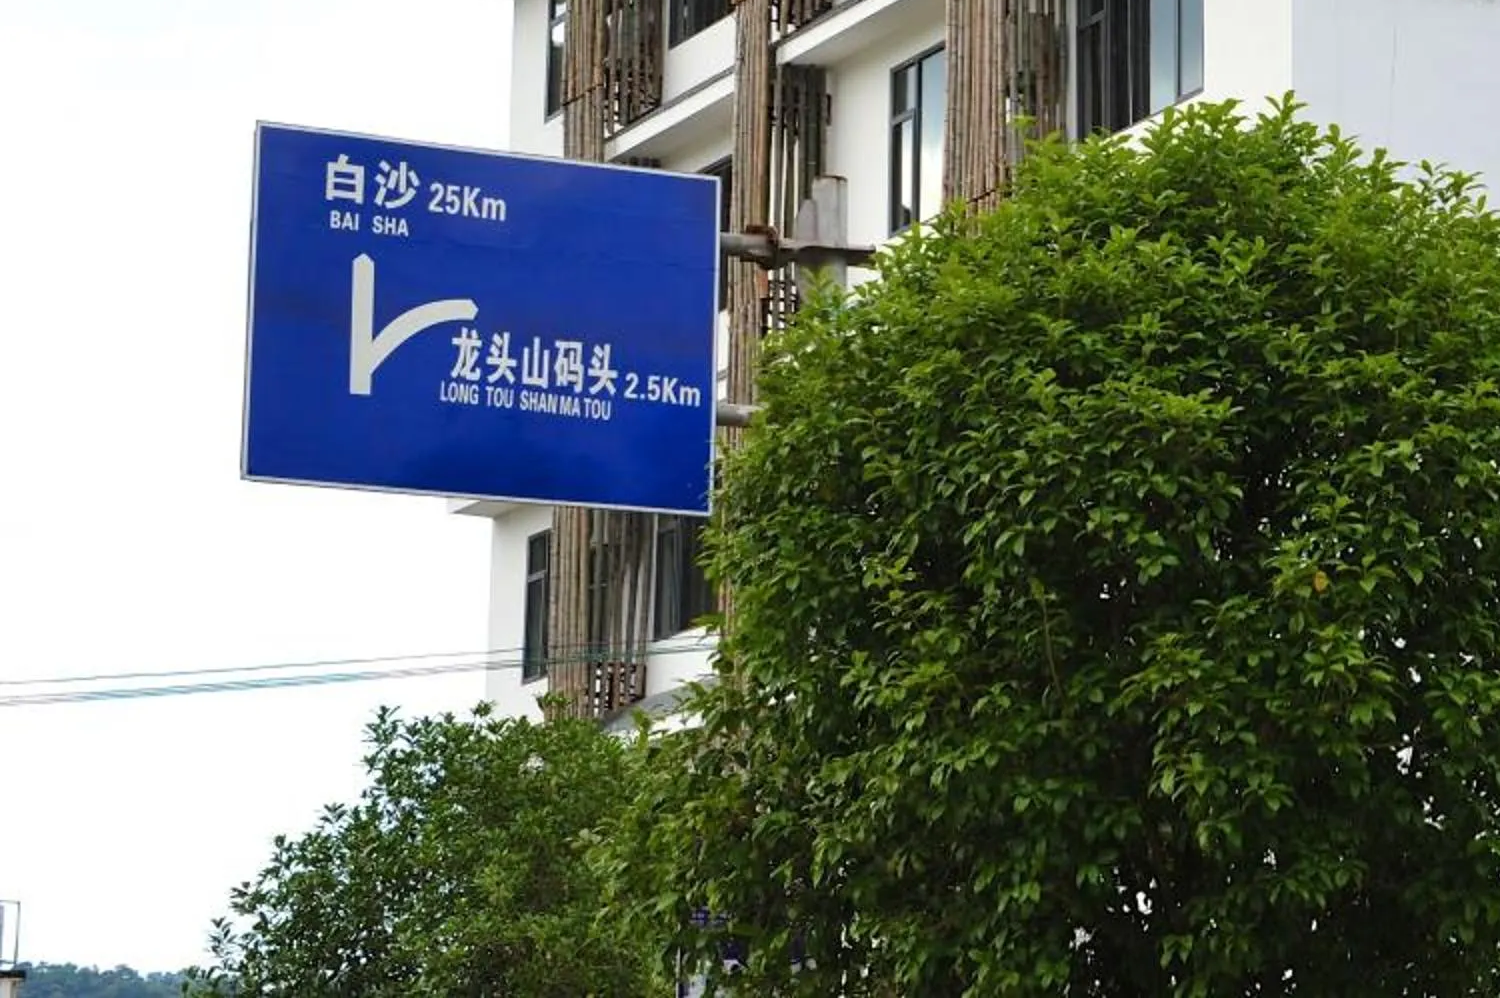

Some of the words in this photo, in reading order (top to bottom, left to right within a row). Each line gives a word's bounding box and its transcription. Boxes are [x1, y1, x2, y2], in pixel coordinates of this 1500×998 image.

[325, 153, 420, 209] 白沙
[428, 182, 506, 222] 25Km
[329, 210, 360, 232] BAI
[372, 214, 409, 237] SHA
[450, 327, 618, 396] 龙头山码头
[623, 372, 701, 408] 2.5Km
[440, 380, 479, 405] LONG
[485, 385, 514, 409] TOU
